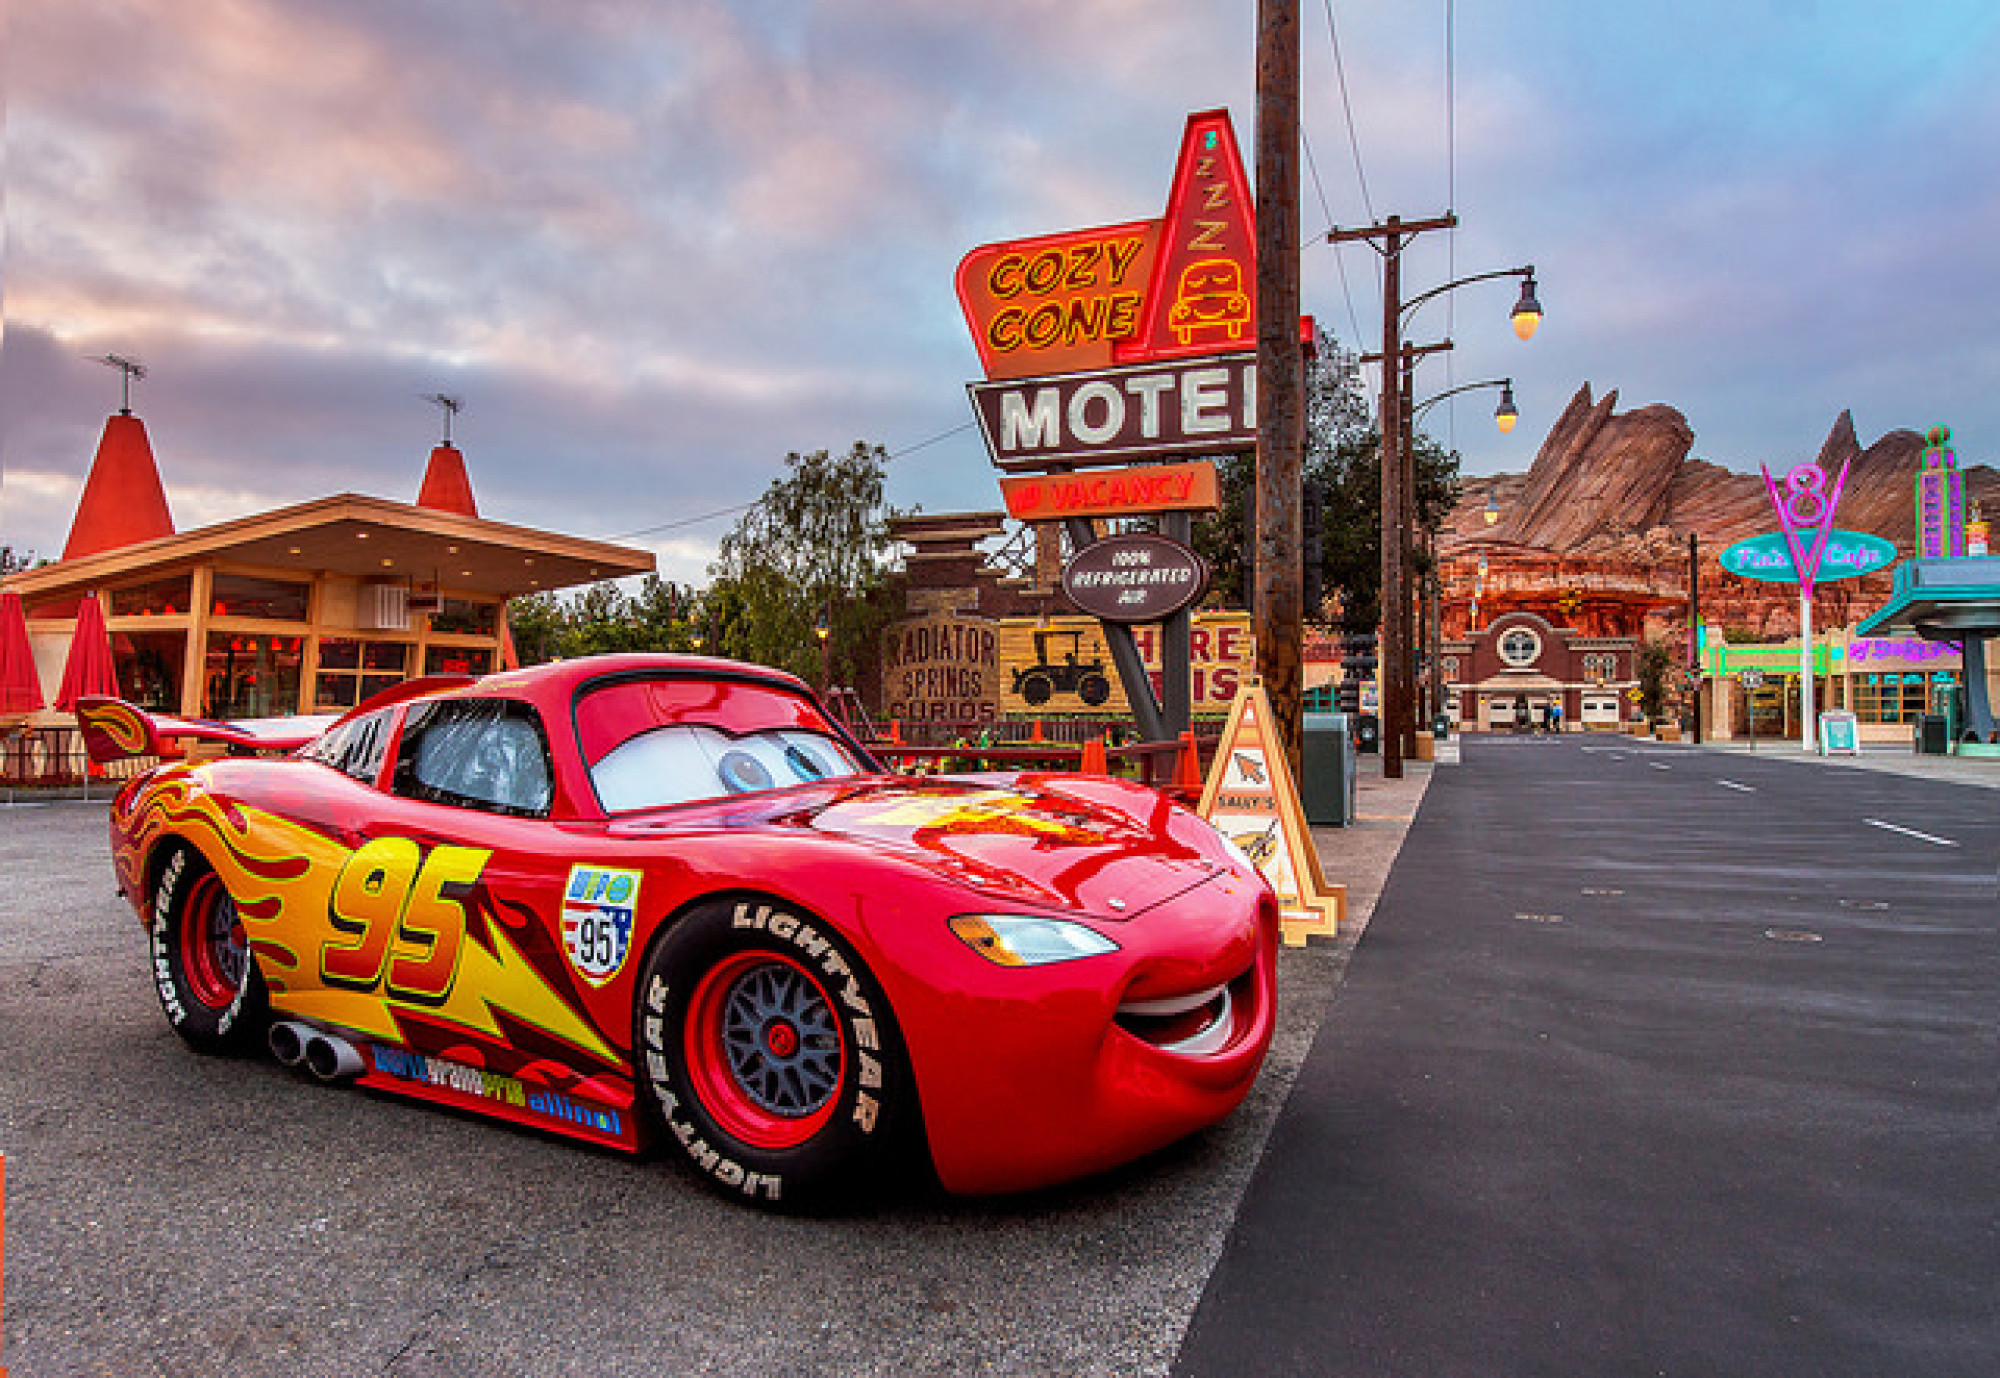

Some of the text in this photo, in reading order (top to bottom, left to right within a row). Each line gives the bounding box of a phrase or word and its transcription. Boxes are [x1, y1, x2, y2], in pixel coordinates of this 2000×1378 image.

[988, 238, 1144, 300] COZY
[988, 291, 1142, 352] CONE
[1051, 473, 1195, 510] VACANCY
[1072, 568, 1191, 588] REFRIGERATED
[1117, 589, 1147, 604] AIR
[888, 624, 996, 669] RADIATOR
[1131, 628, 1242, 662] HRE
[903, 667, 983, 700] SPRINGS
[1193, 668, 1239, 702] IS
[319, 837, 493, 1005] 95
[580, 916, 612, 967] 95
[732, 903, 882, 1134] LIGHTYEAR
[646, 974, 782, 1200] LIGHTYEAR
[529, 1090, 623, 1136] allinol
